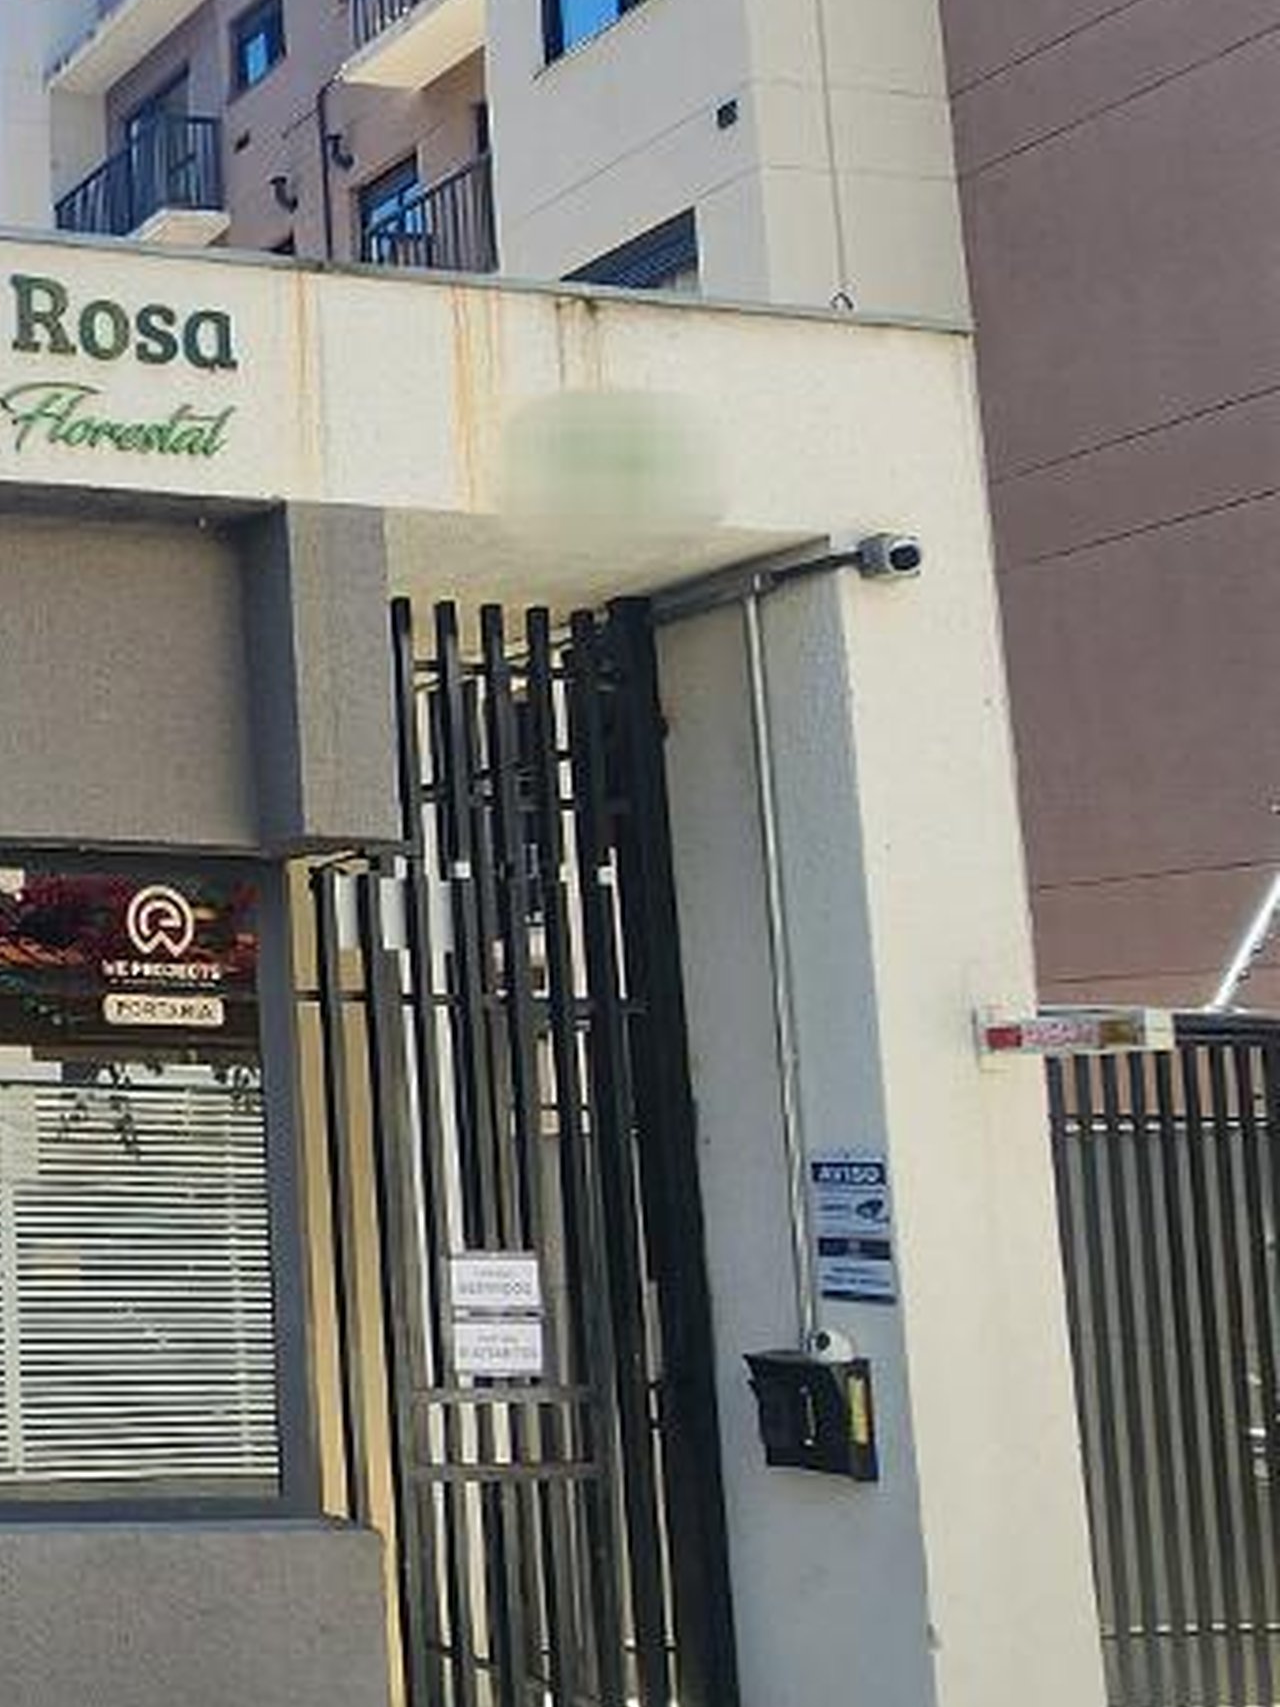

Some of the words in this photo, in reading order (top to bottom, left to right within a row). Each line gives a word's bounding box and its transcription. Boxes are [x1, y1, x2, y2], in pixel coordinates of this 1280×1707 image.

[10, 273, 239, 372] Rosa
[2, 381, 236, 458] Florestal
[115, 1000, 214, 1019] PORTARIA
[817, 1165, 881, 1184] AVISO
